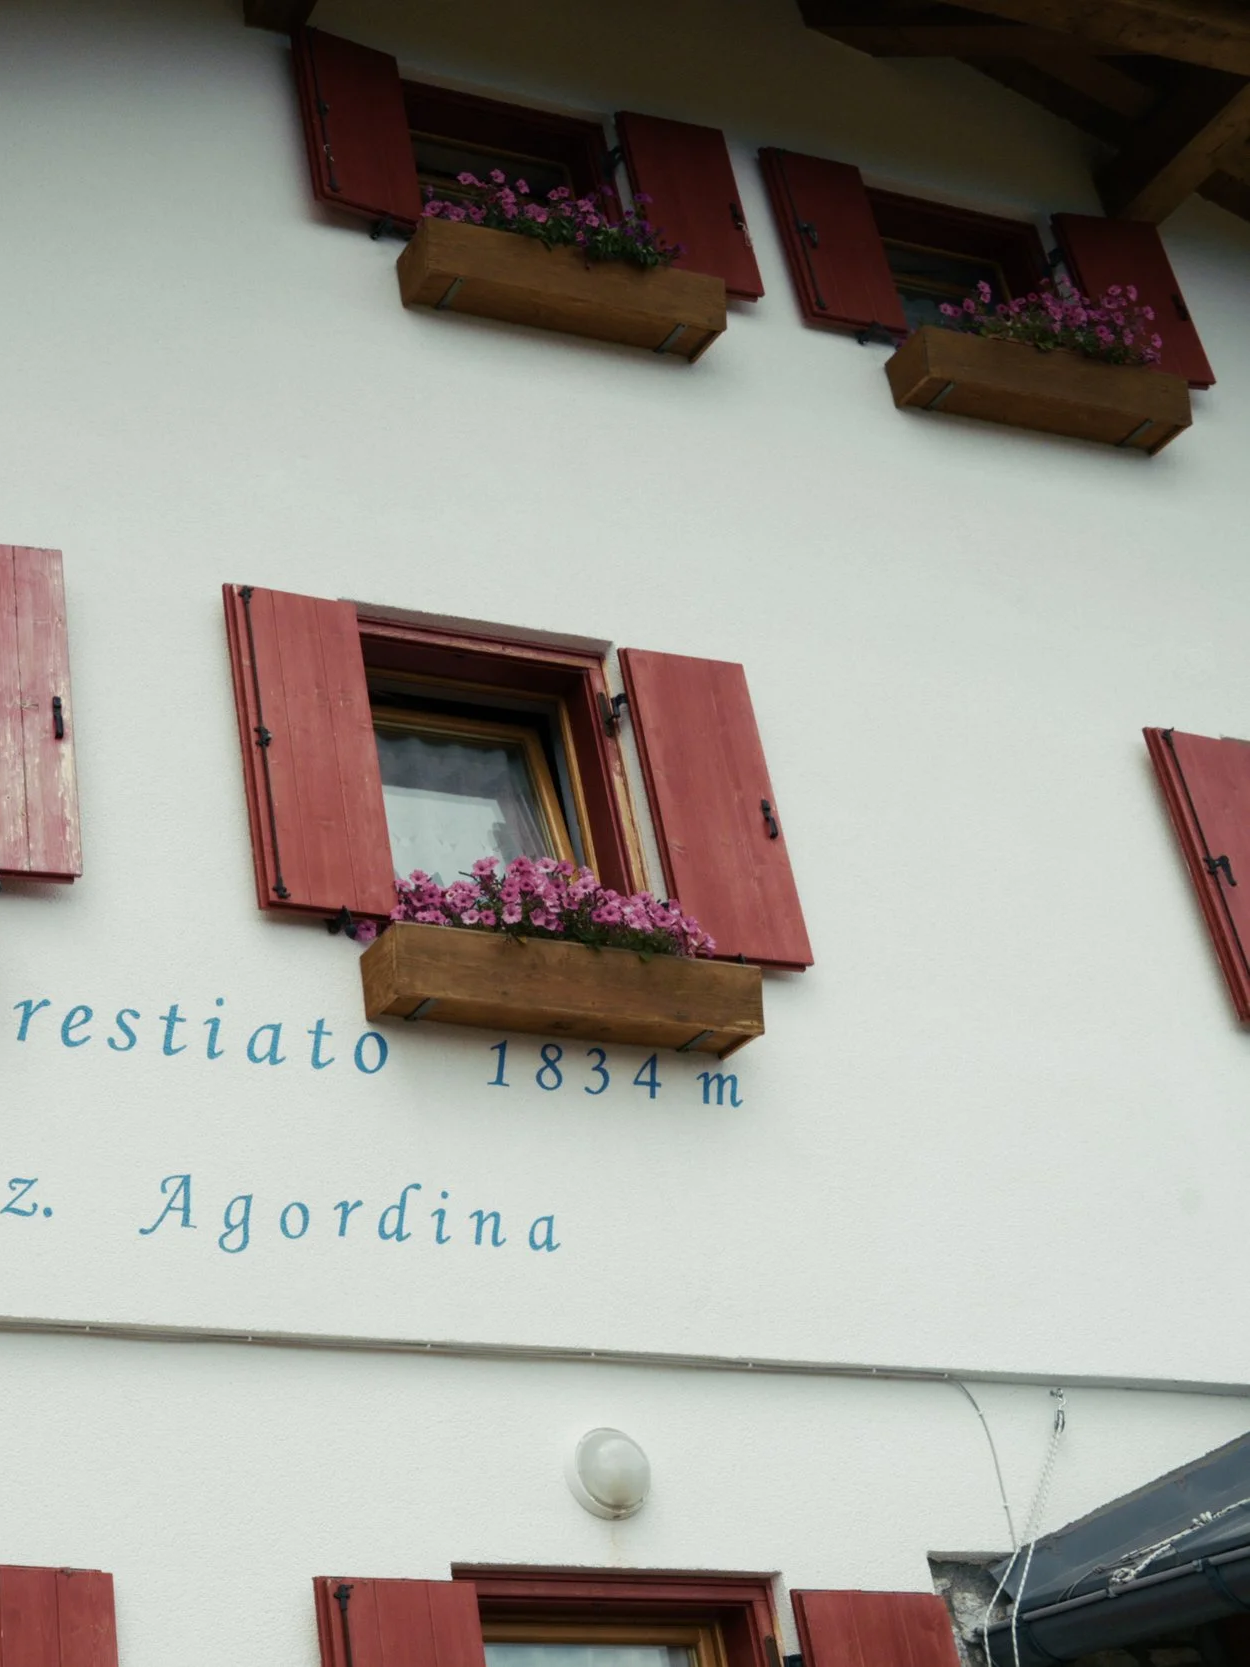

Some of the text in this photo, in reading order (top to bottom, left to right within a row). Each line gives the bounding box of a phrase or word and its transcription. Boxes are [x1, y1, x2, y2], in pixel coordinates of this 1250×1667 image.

[486, 1040, 663, 1099] 1834
[696, 1070, 744, 1108] m
[138, 1173, 561, 1254] Agordina
